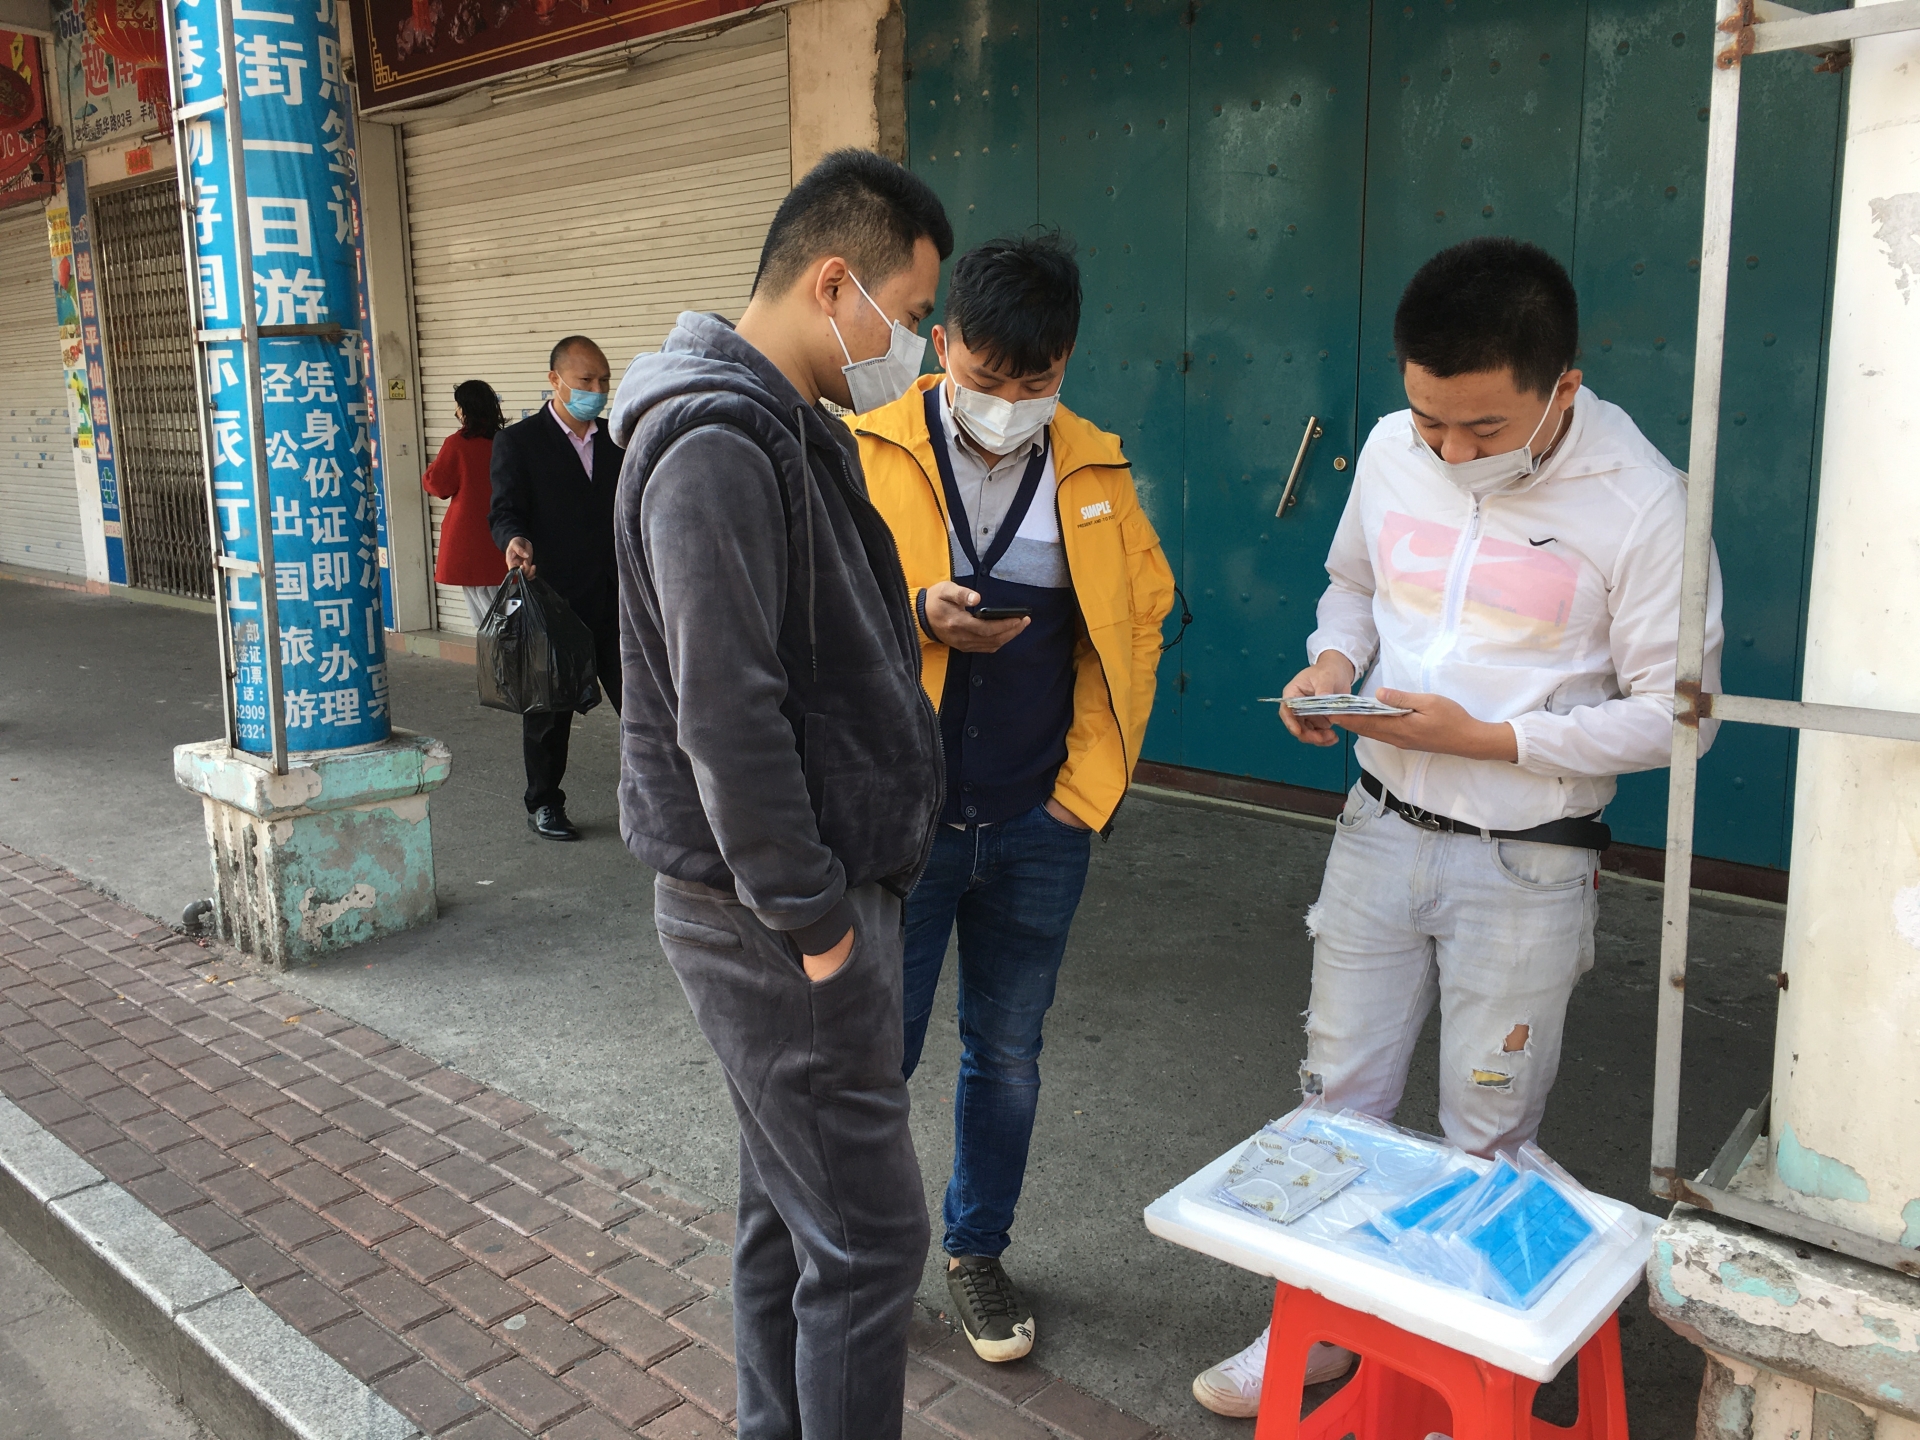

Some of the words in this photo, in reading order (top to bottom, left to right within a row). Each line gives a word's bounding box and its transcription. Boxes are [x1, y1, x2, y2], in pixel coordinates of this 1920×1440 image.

[219, 0, 329, 326] 街一日游
[235, 645, 262, 663] 签证
[260, 363, 319, 730] 轻松出国旅游
[293, 360, 362, 728] 凭身份证即可办理
[1080, 501, 1111, 519] SIMPLE
